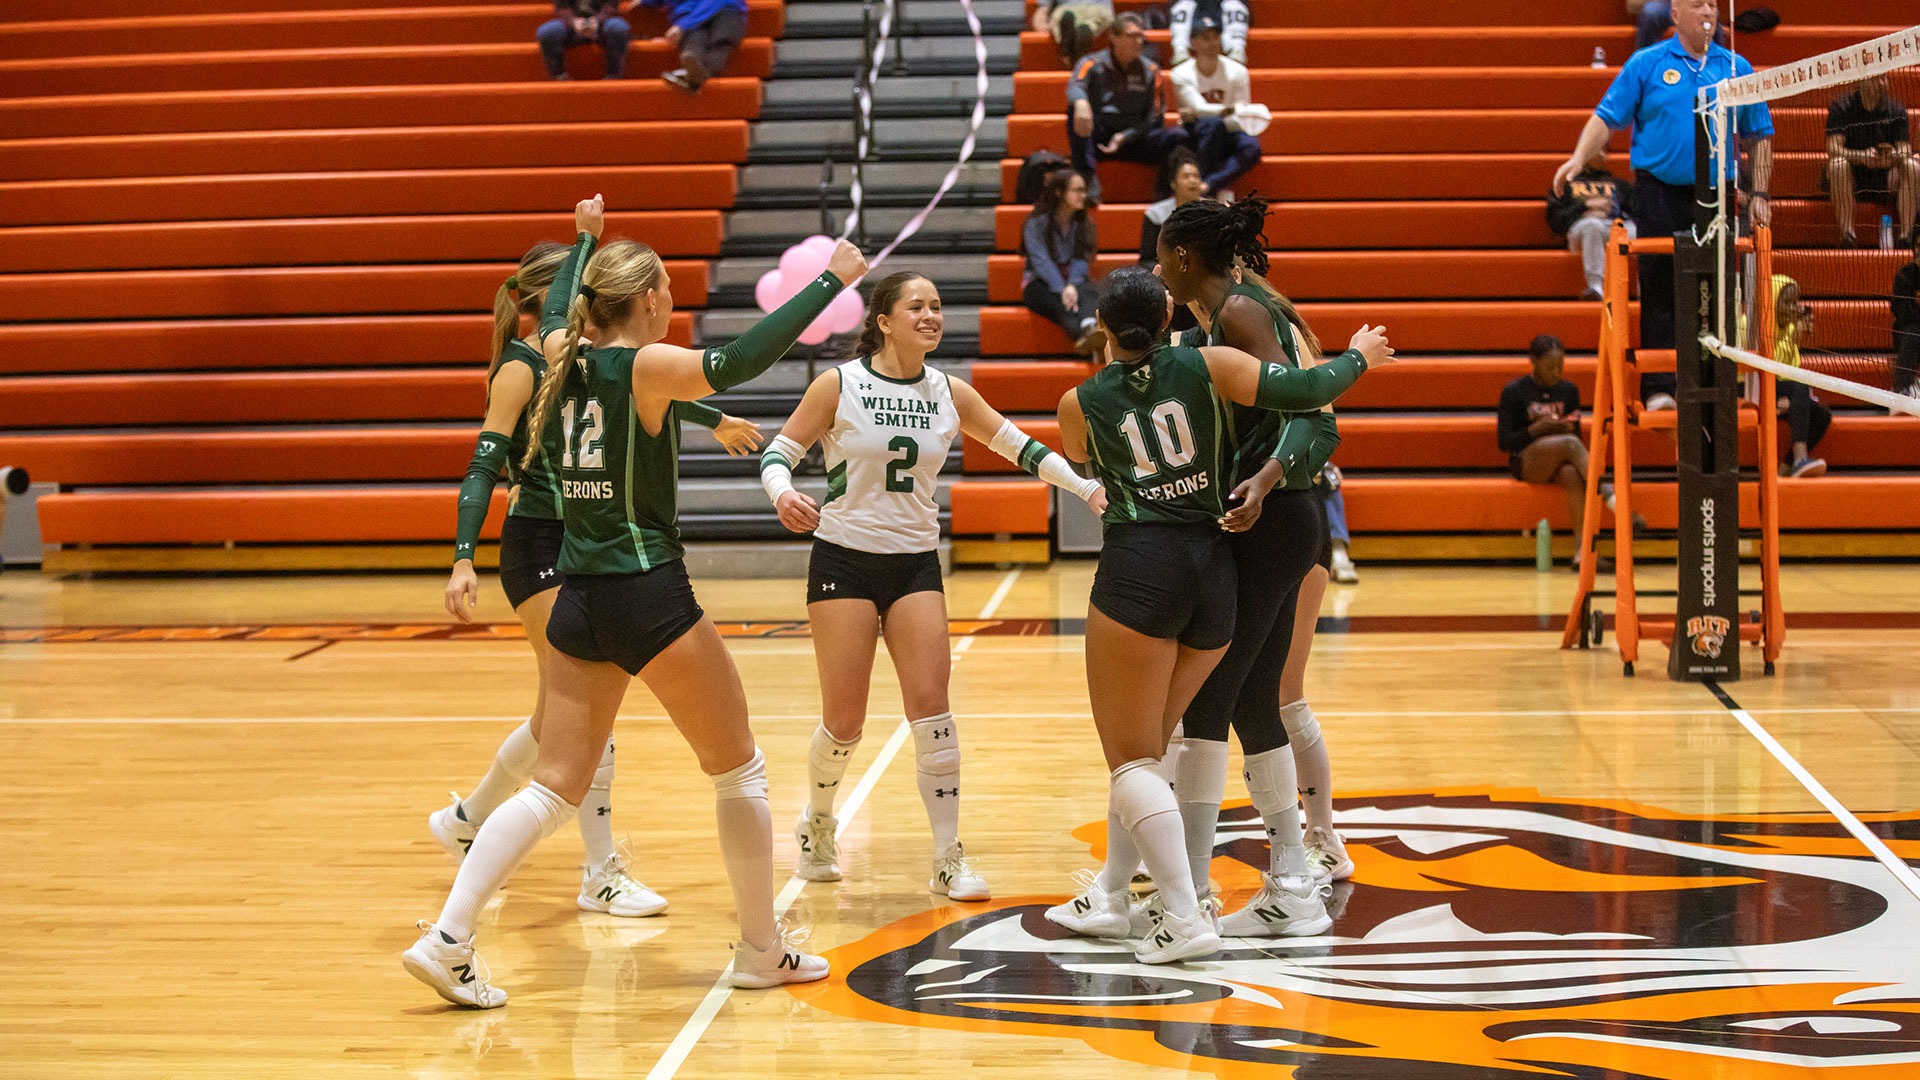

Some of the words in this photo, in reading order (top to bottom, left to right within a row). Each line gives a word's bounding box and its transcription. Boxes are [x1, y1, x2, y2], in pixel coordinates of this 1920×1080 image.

[1570, 181, 1616, 199] RIT
[861, 396, 939, 415] WILLIAM
[875, 412, 931, 430] SMITH
[561, 397, 606, 471] 12
[1117, 397, 1198, 481] 10
[886, 435, 919, 493] 2
[562, 480, 614, 499] ERONS
[1700, 498, 1717, 546] sports
[1700, 548, 1717, 608] imports
[1687, 614, 1730, 638] RIT
[596, 885, 622, 902] N
[1074, 896, 1091, 914] N
[1253, 904, 1290, 923] N
[1154, 929, 1174, 948] N
[778, 953, 800, 970] N
[451, 963, 476, 984] N
